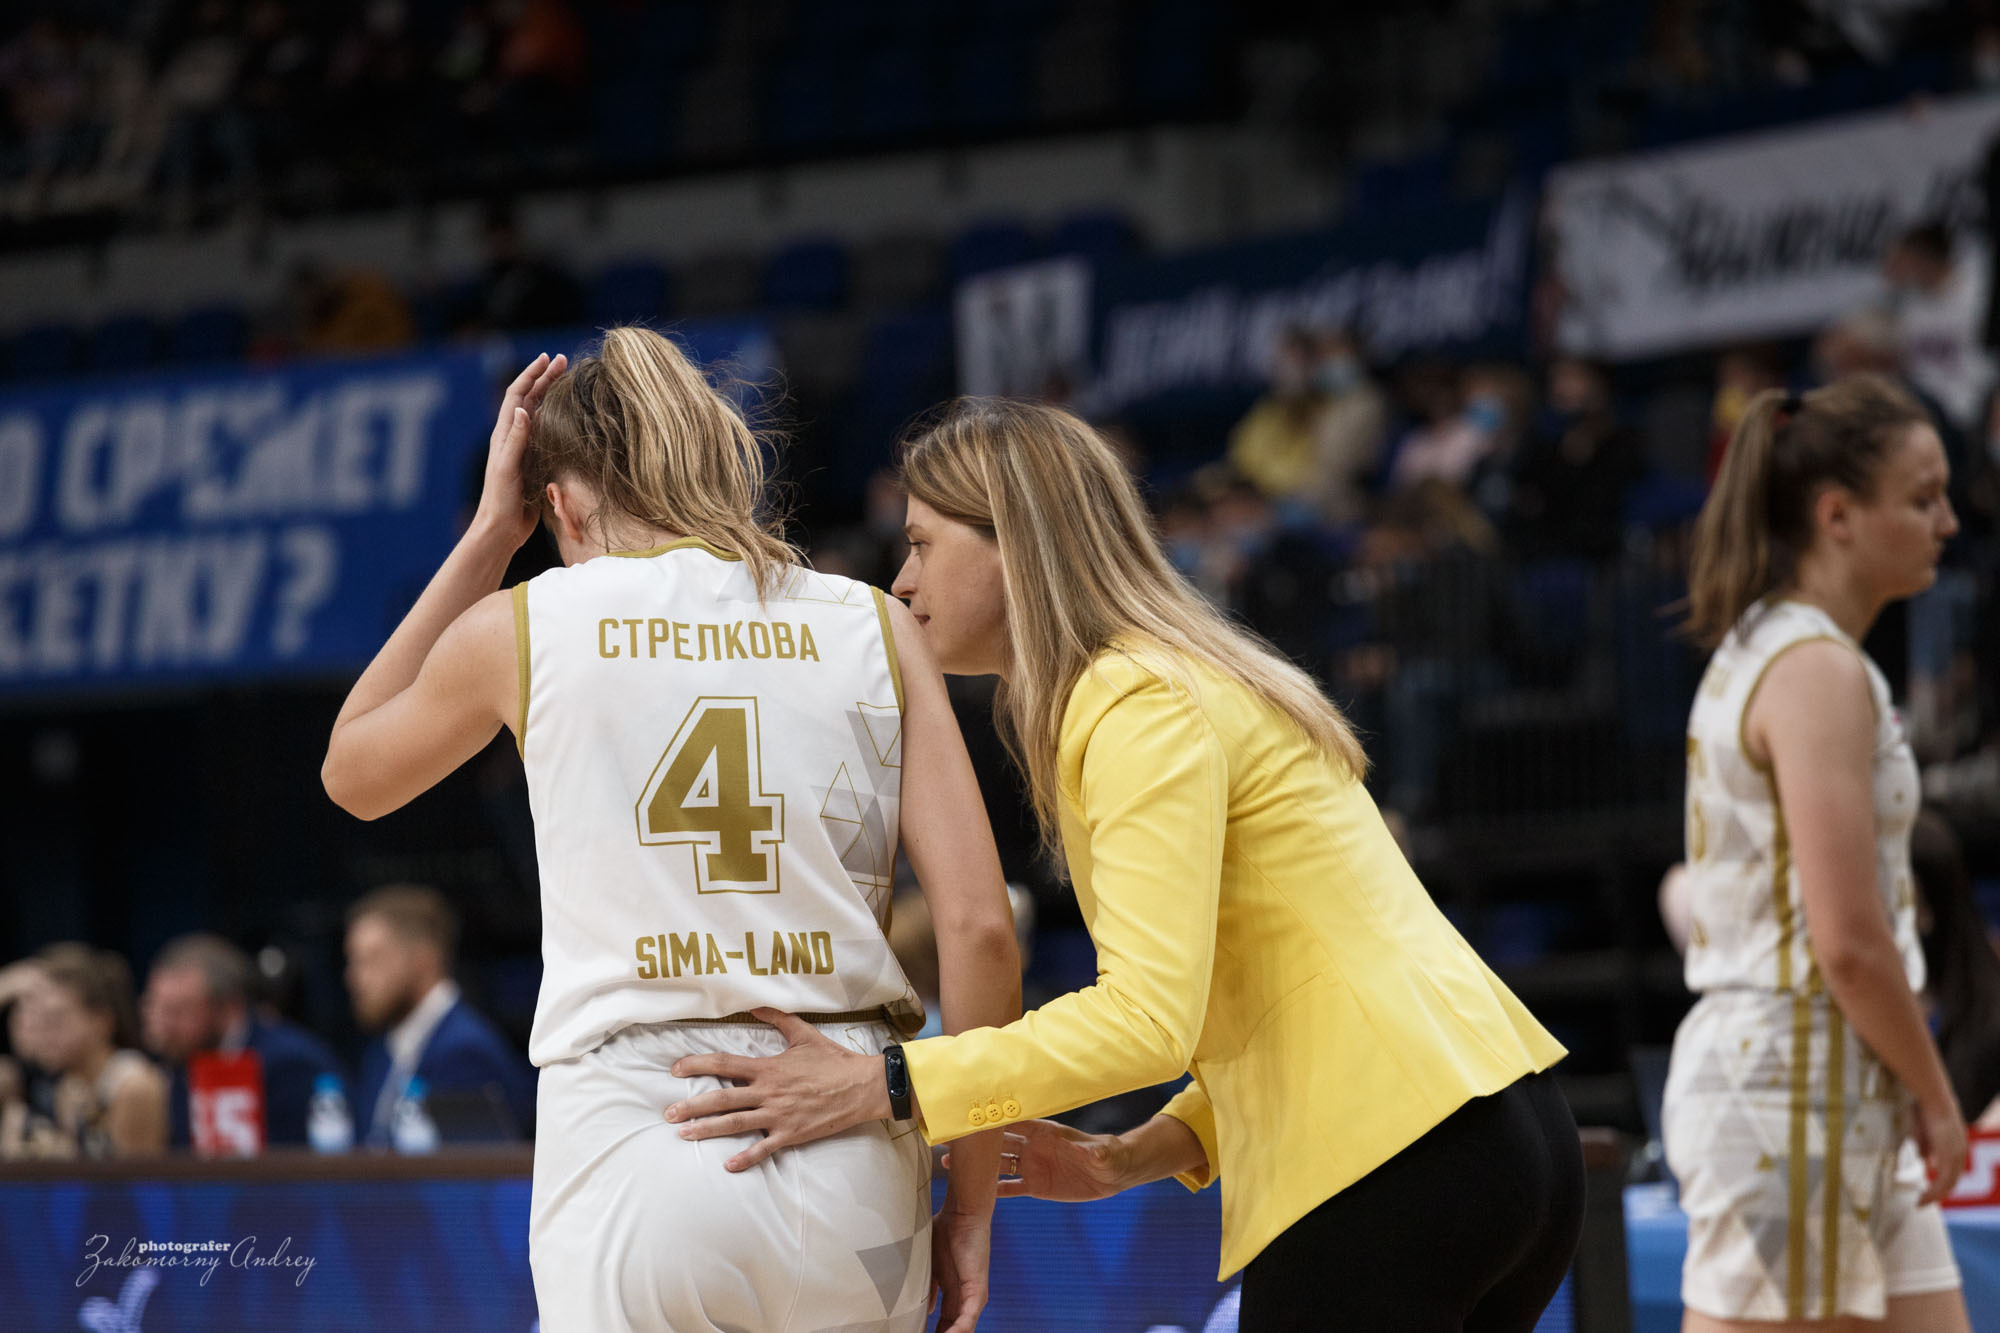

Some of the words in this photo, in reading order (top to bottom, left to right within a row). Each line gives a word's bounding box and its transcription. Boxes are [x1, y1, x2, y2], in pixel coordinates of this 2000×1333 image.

[598, 617, 820, 663] СТРЕЛКОВА
[635, 696, 785, 895] 4
[635, 930, 835, 980] SIMA-LAND
